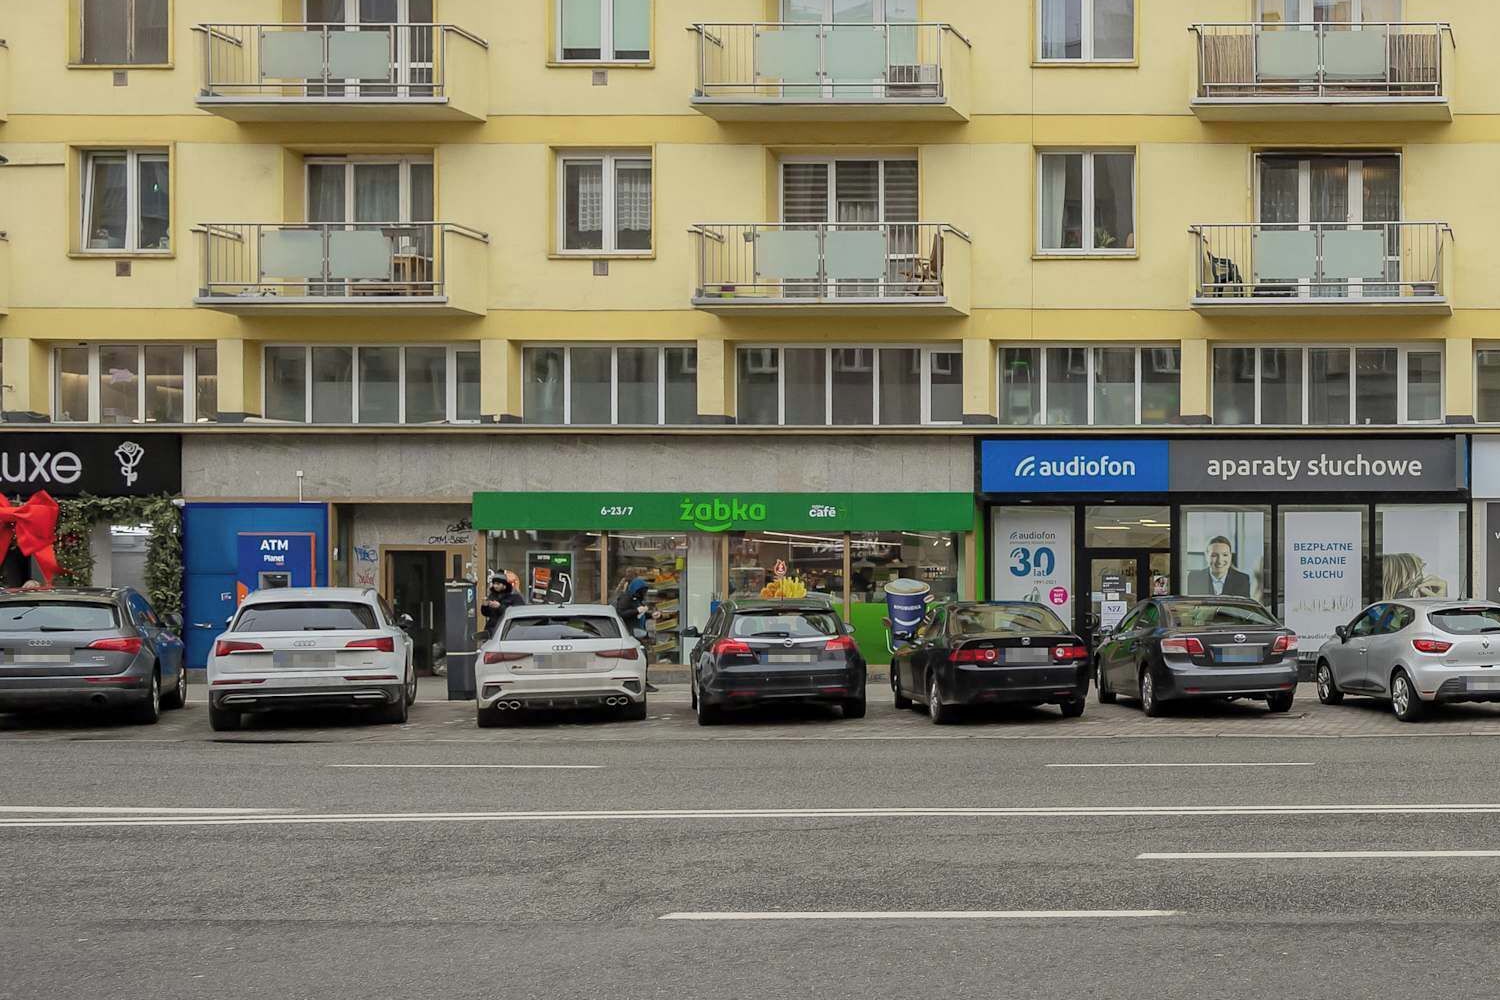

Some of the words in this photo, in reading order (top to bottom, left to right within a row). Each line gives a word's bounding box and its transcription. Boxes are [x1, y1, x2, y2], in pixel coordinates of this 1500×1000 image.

[0, 451, 82, 484] uxe
[1039, 455, 1136, 476] audiofon
[1207, 456, 1300, 480] aparaty
[1307, 454, 1423, 476] słuchowe
[600, 506, 634, 516] 6-23/7
[679, 498, 766, 521] żabka
[1018, 531, 1056, 540] audiofon
[260, 540, 289, 551] ATM
[1293, 542, 1353, 551] BEZPŁATNE
[264, 554, 284, 562] Planet
[1009, 546, 1055, 577] 30
[1300, 556, 1346, 565] BADANIE
[1302, 570, 1344, 579] SŁUCHU
